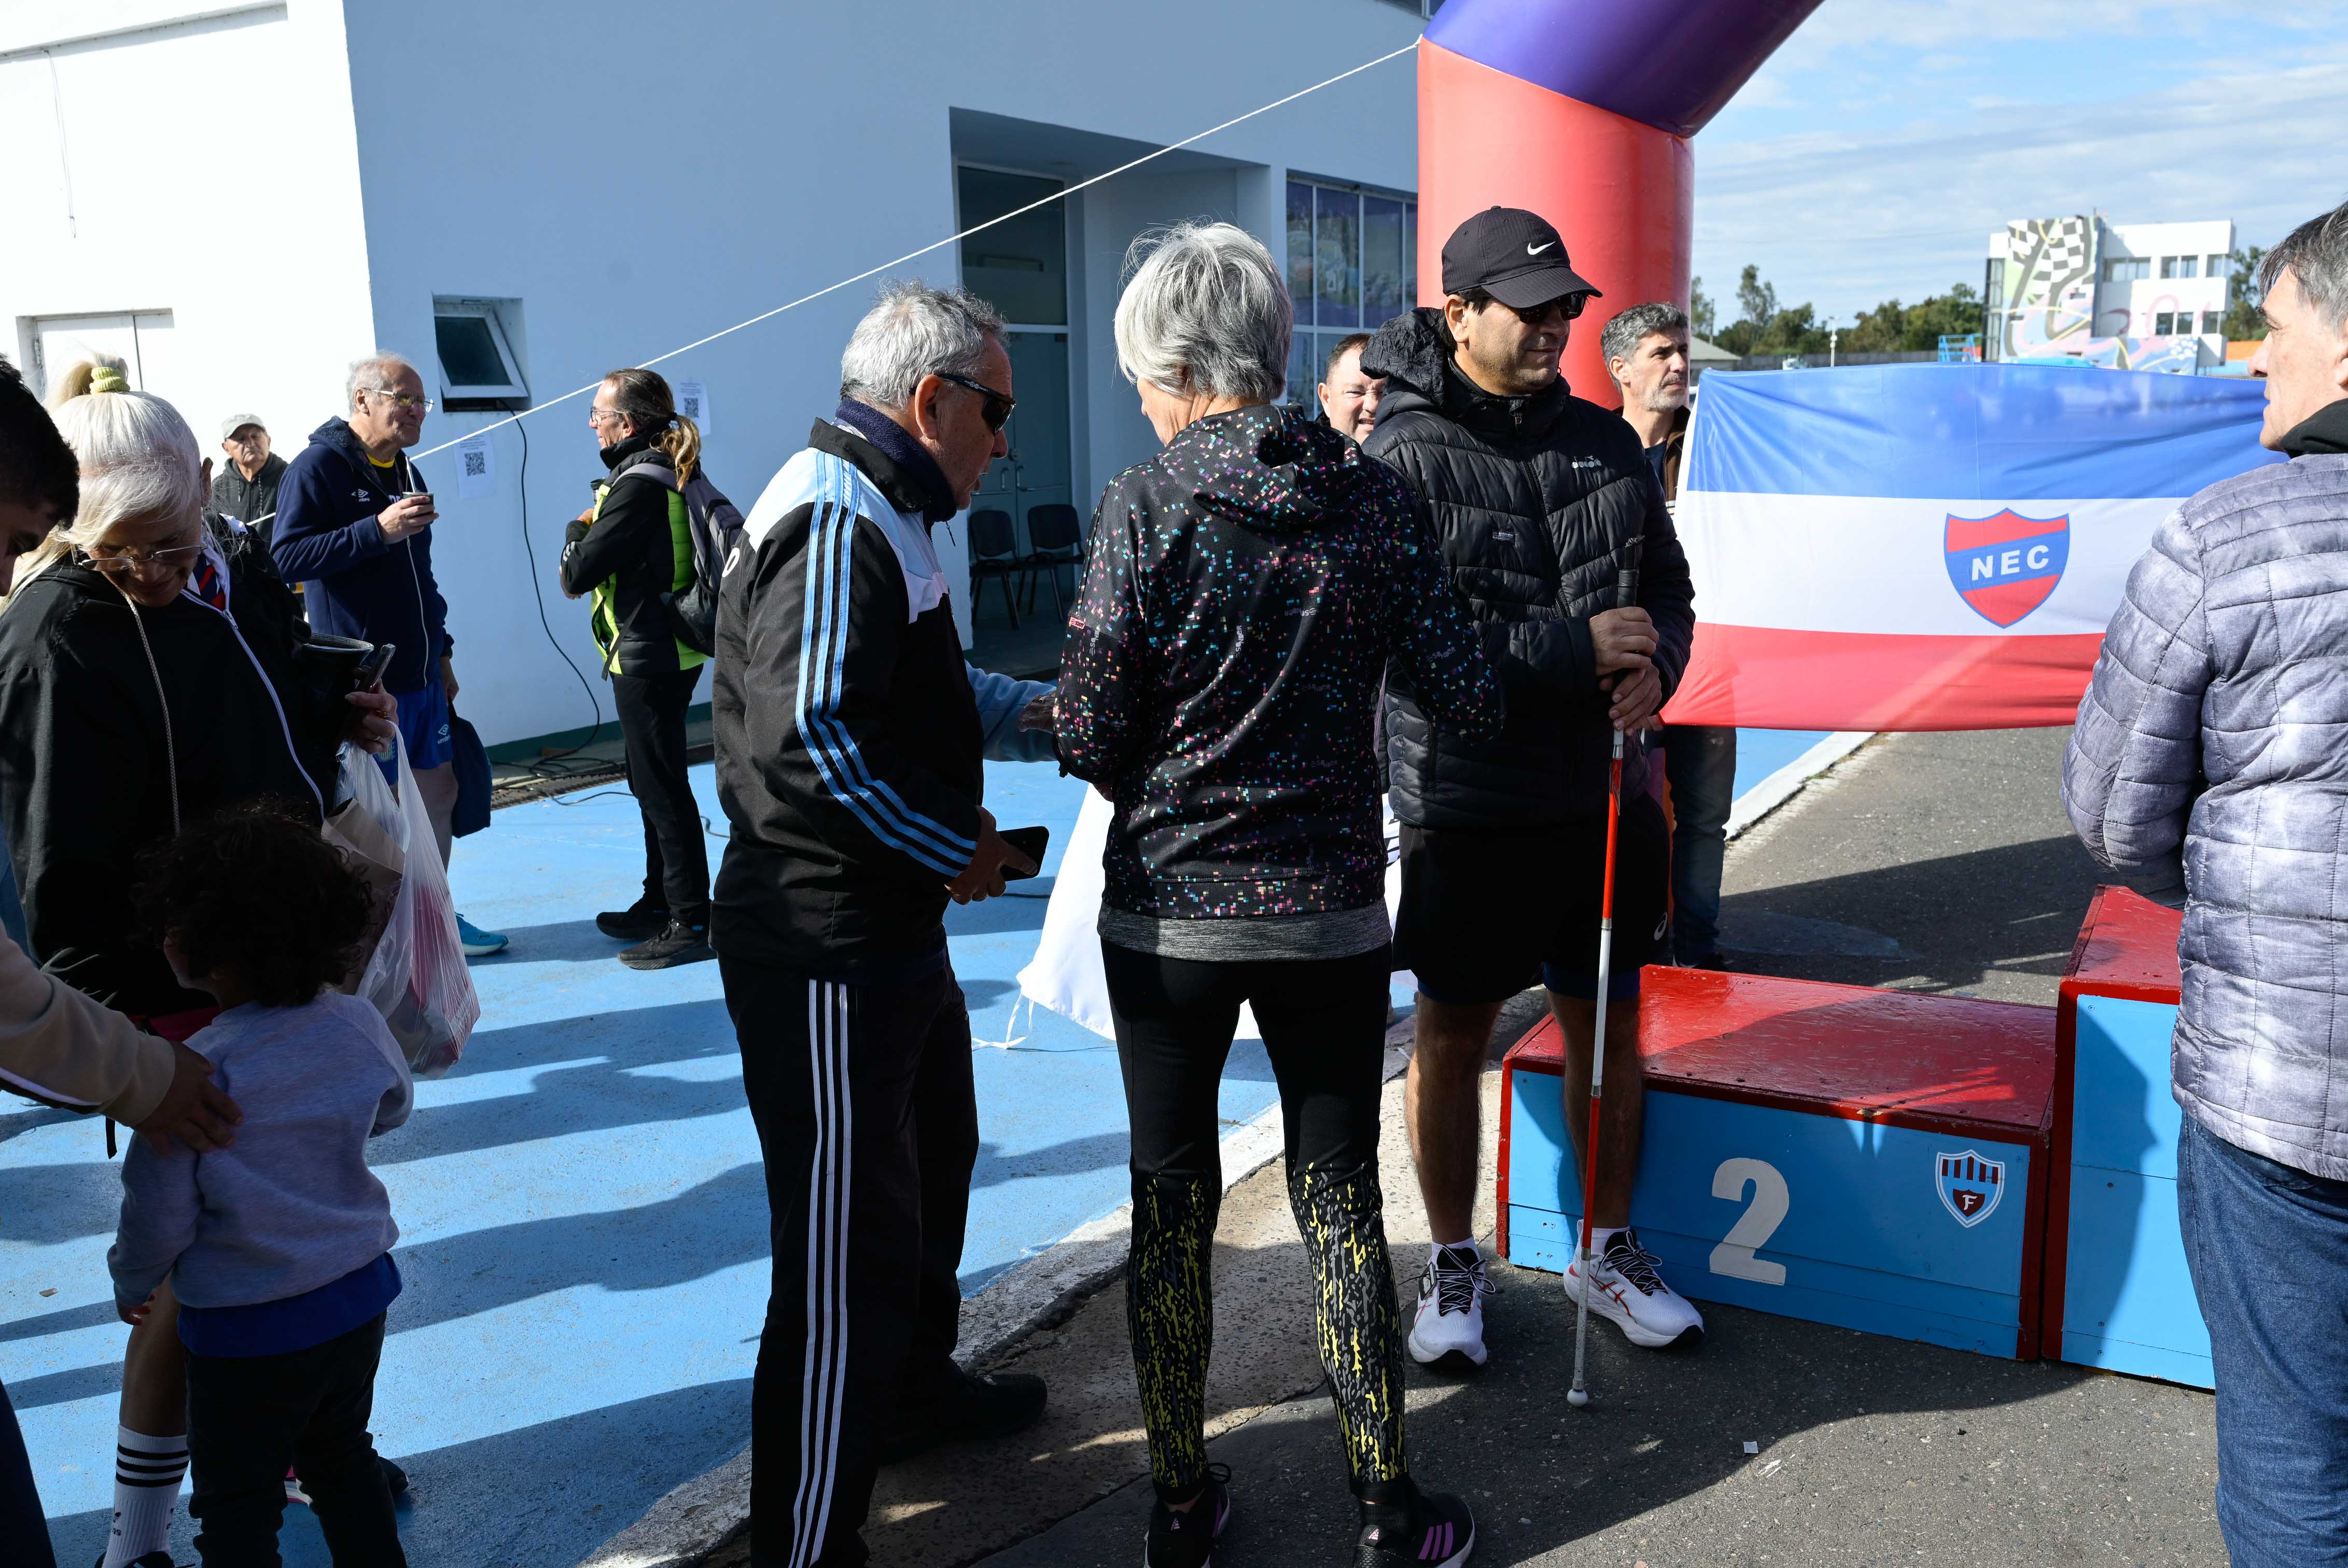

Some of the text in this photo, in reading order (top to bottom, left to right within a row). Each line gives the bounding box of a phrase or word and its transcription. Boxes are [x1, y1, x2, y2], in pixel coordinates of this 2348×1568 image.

[1971, 544, 2050, 581] NEC
[1962, 1194, 1978, 1211] F
[1709, 1157, 1790, 1286] 2
